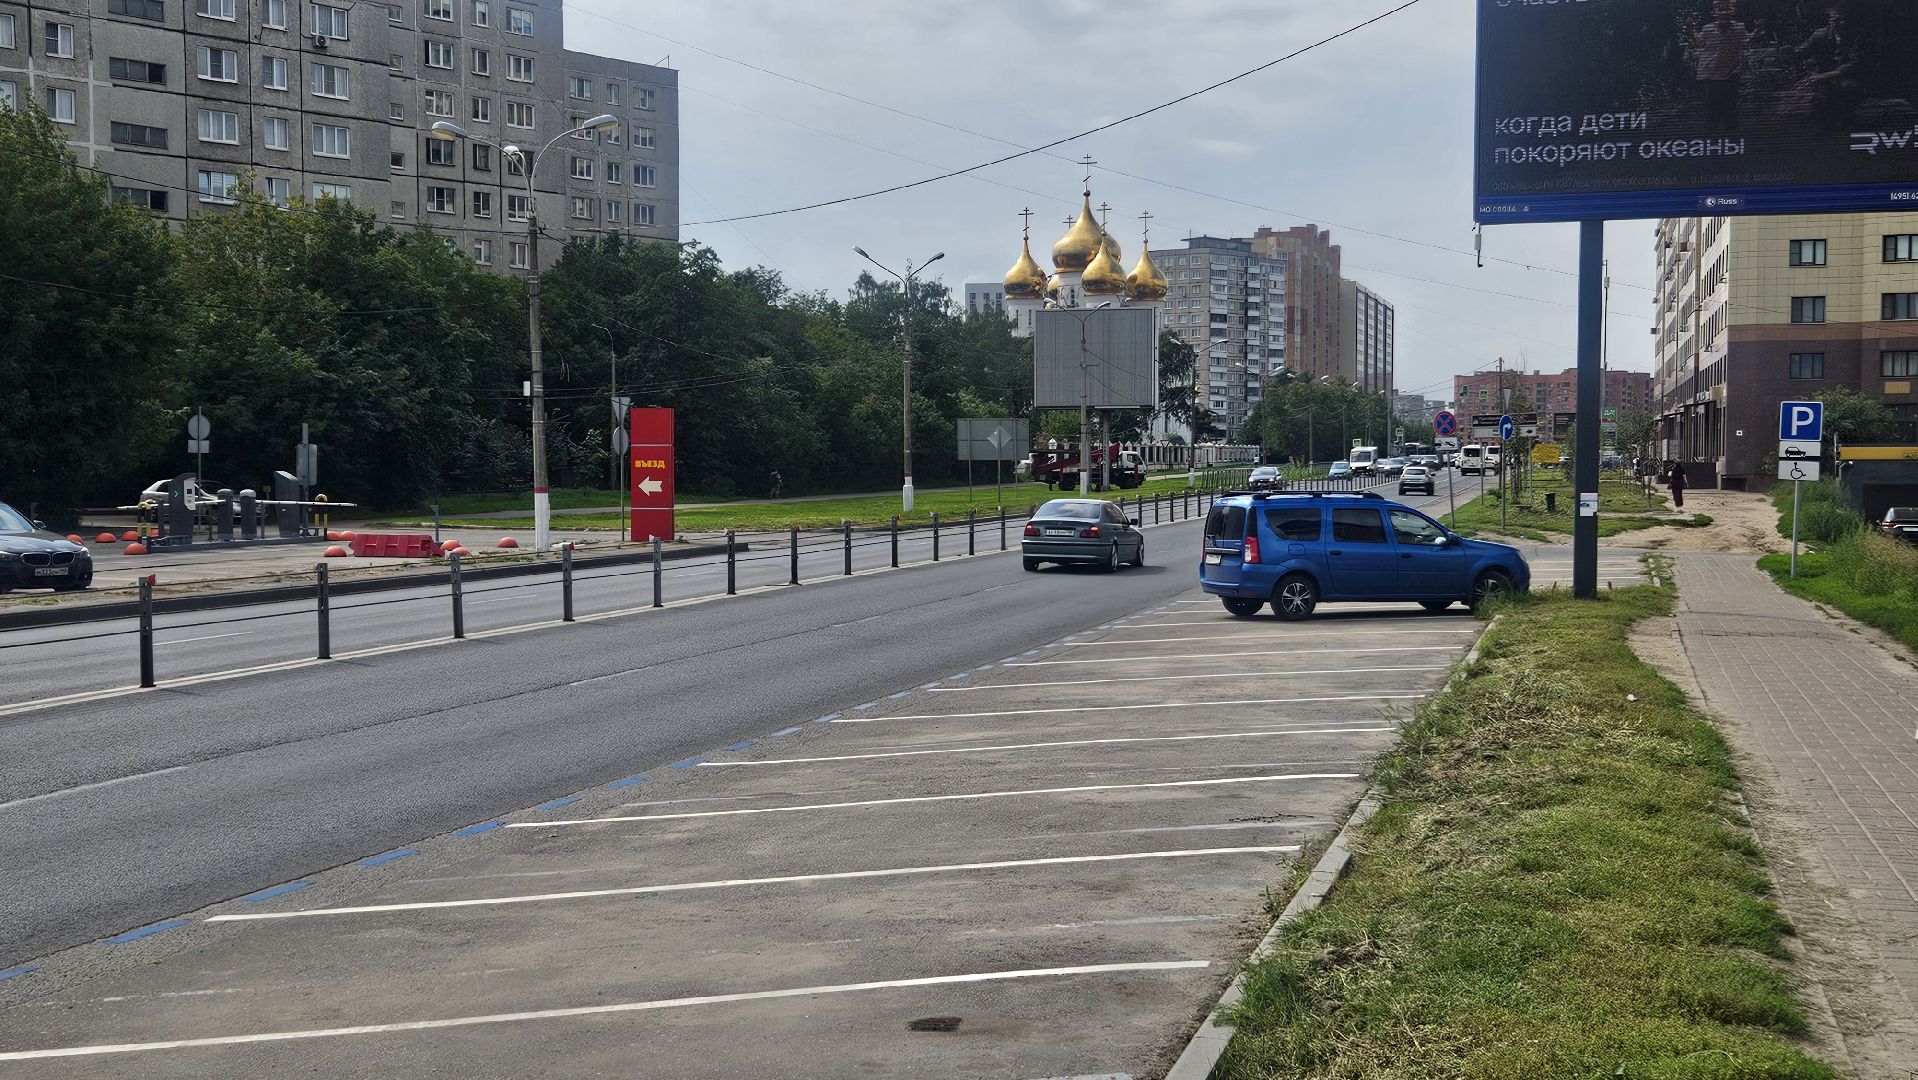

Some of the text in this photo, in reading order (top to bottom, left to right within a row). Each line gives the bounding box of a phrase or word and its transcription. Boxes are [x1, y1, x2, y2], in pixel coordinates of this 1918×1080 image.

[1495, 111, 1647, 138] когда дети
[1494, 138, 1745, 167] покоряют океаны
[1849, 124, 1918, 155] RW
[1791, 406, 1815, 436] P
[635, 460, 666, 469] ВЪЕЗД
